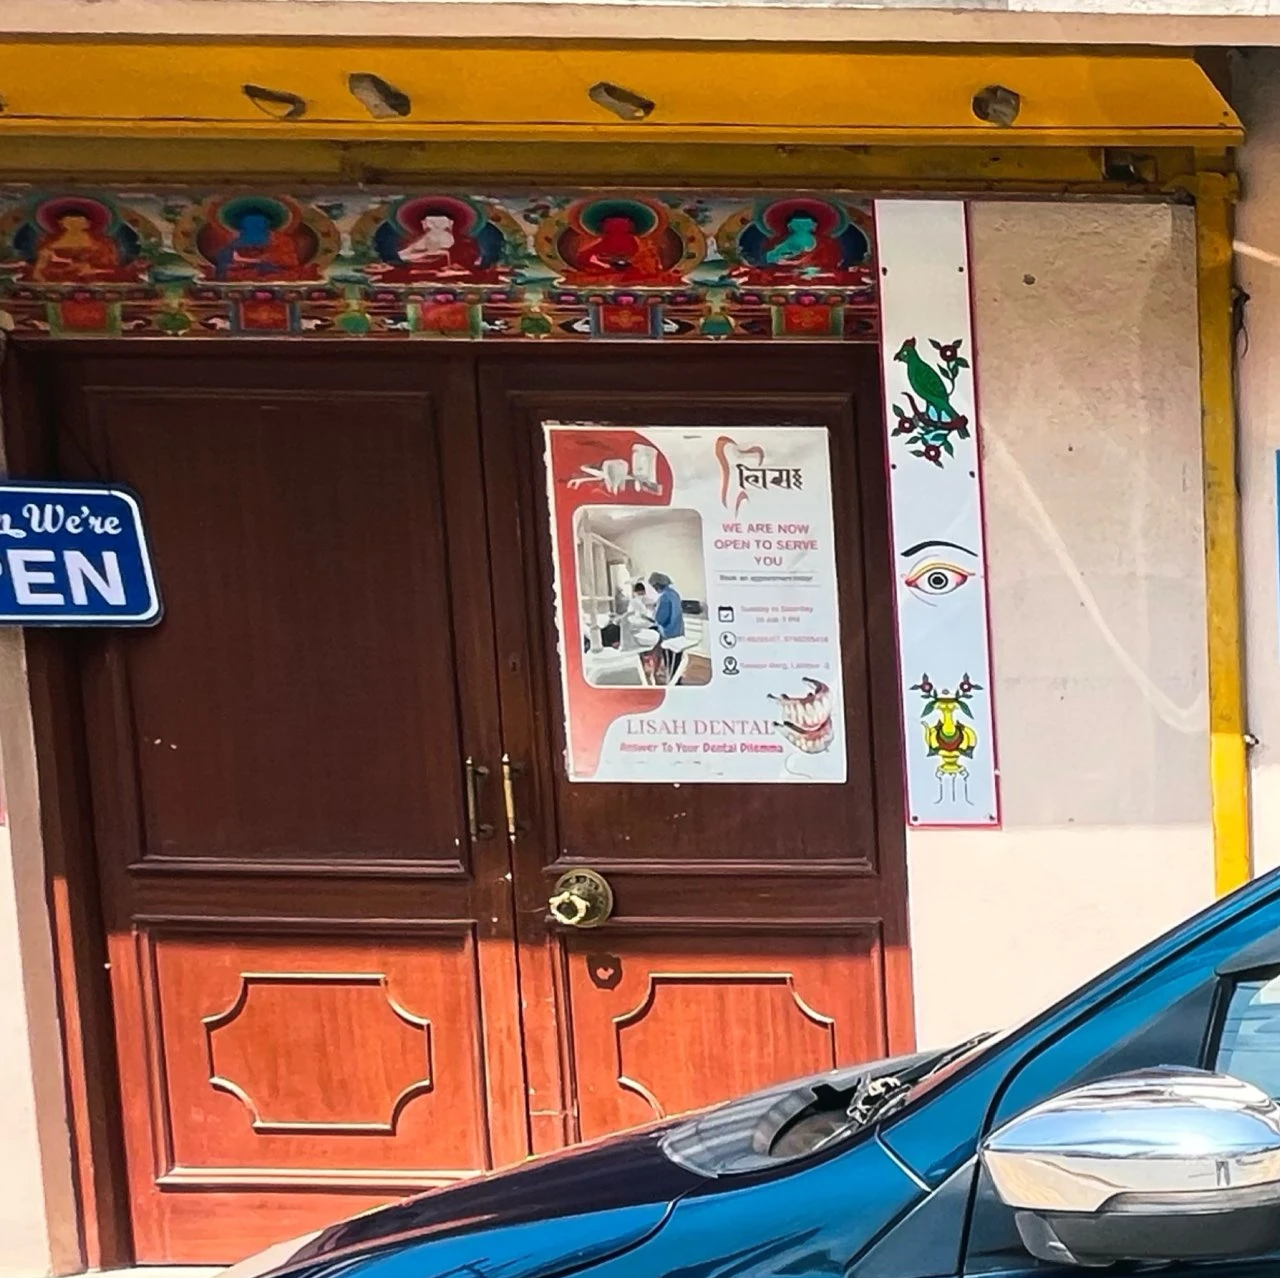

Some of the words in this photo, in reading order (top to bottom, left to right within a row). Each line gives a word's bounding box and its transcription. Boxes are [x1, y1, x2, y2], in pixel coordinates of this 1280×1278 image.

[21, 503, 123, 535] We're
[722, 523, 742, 533] WE
[747, 523, 773, 533] ARE
[777, 523, 809, 534] NOW
[714, 539, 750, 549] OPEN
[754, 539, 772, 549] TO
[776, 539, 818, 550] SERVE
[754, 556, 782, 566] YOU
[626, 719, 686, 735] LISAH
[694, 719, 774, 735] DENTAL
[662, 742, 672, 752] To
[676, 742, 698, 752] Your
[703, 742, 736, 752] Dental
[740, 742, 783, 752] Dilemma
